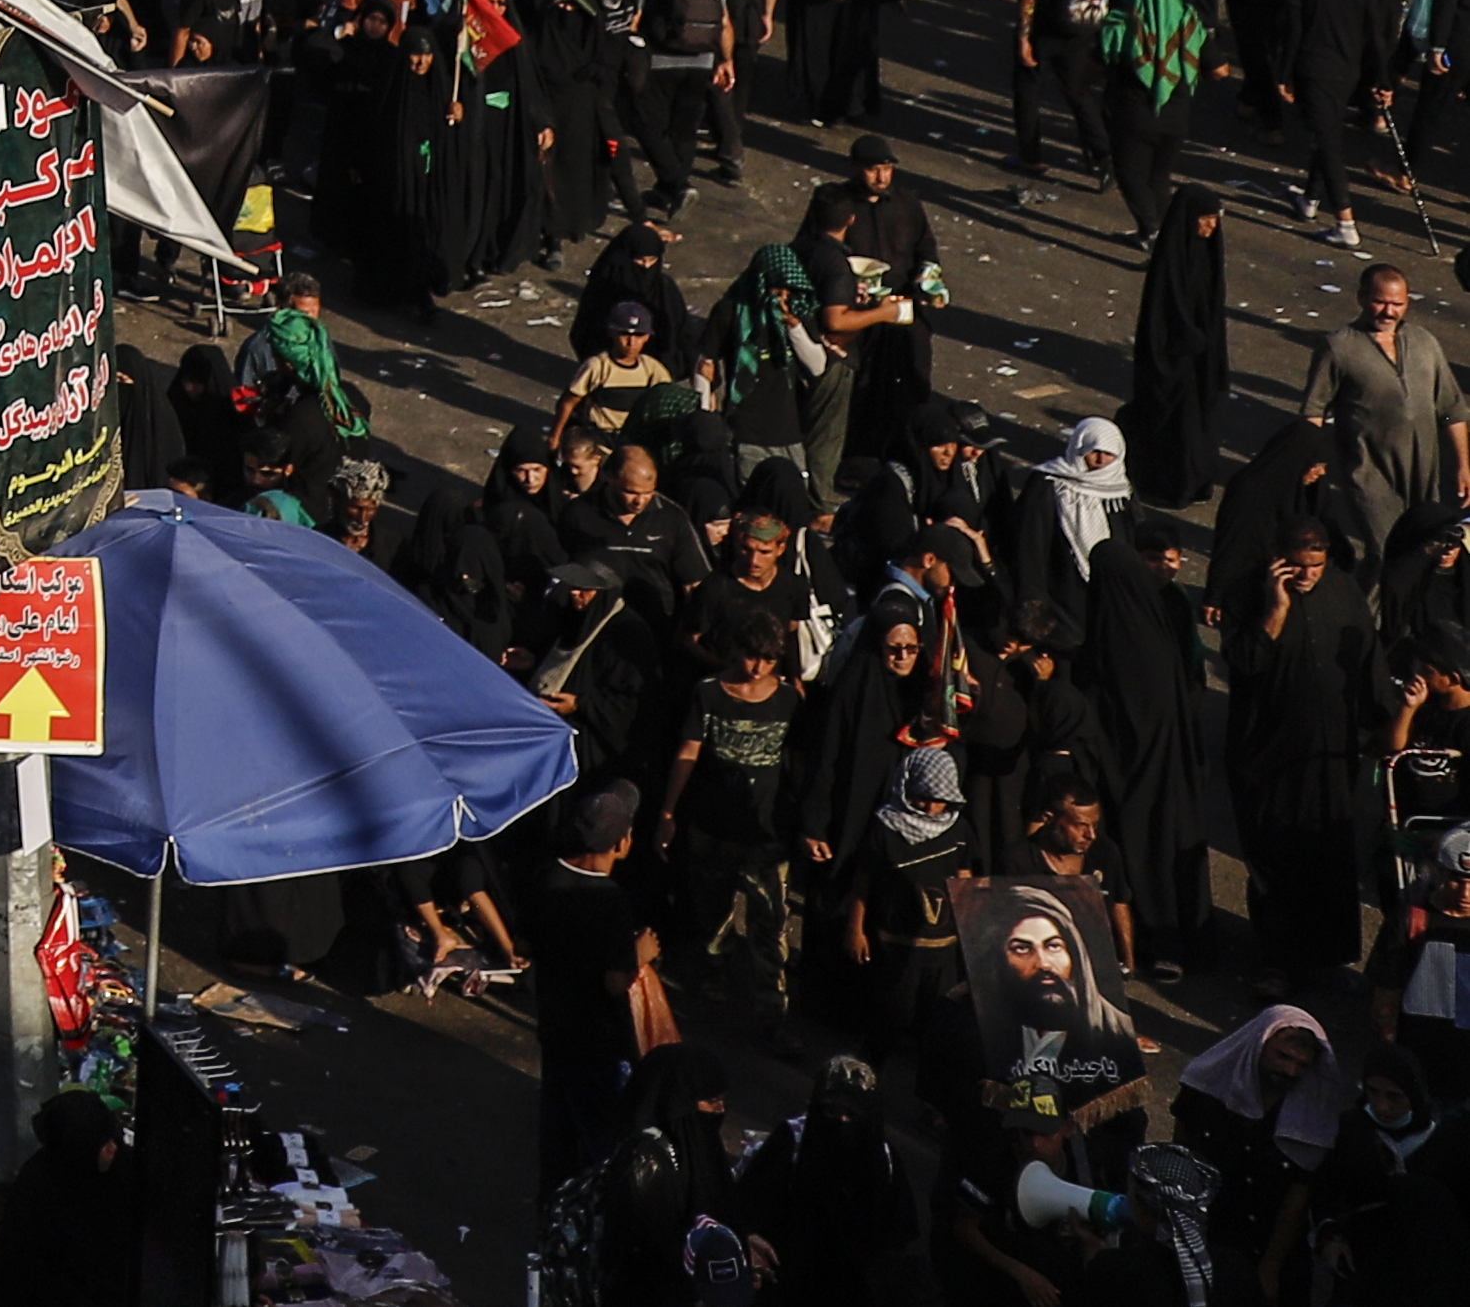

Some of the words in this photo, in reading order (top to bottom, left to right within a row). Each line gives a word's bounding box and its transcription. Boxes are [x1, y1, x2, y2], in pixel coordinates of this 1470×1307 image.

[14, 77, 80, 139] مود
[37, 566, 84, 602] موكب
[42, 606, 79, 642] امام
[1062, 1058, 1102, 1083] حيدر
[1102, 1056, 1120, 1084] يا
